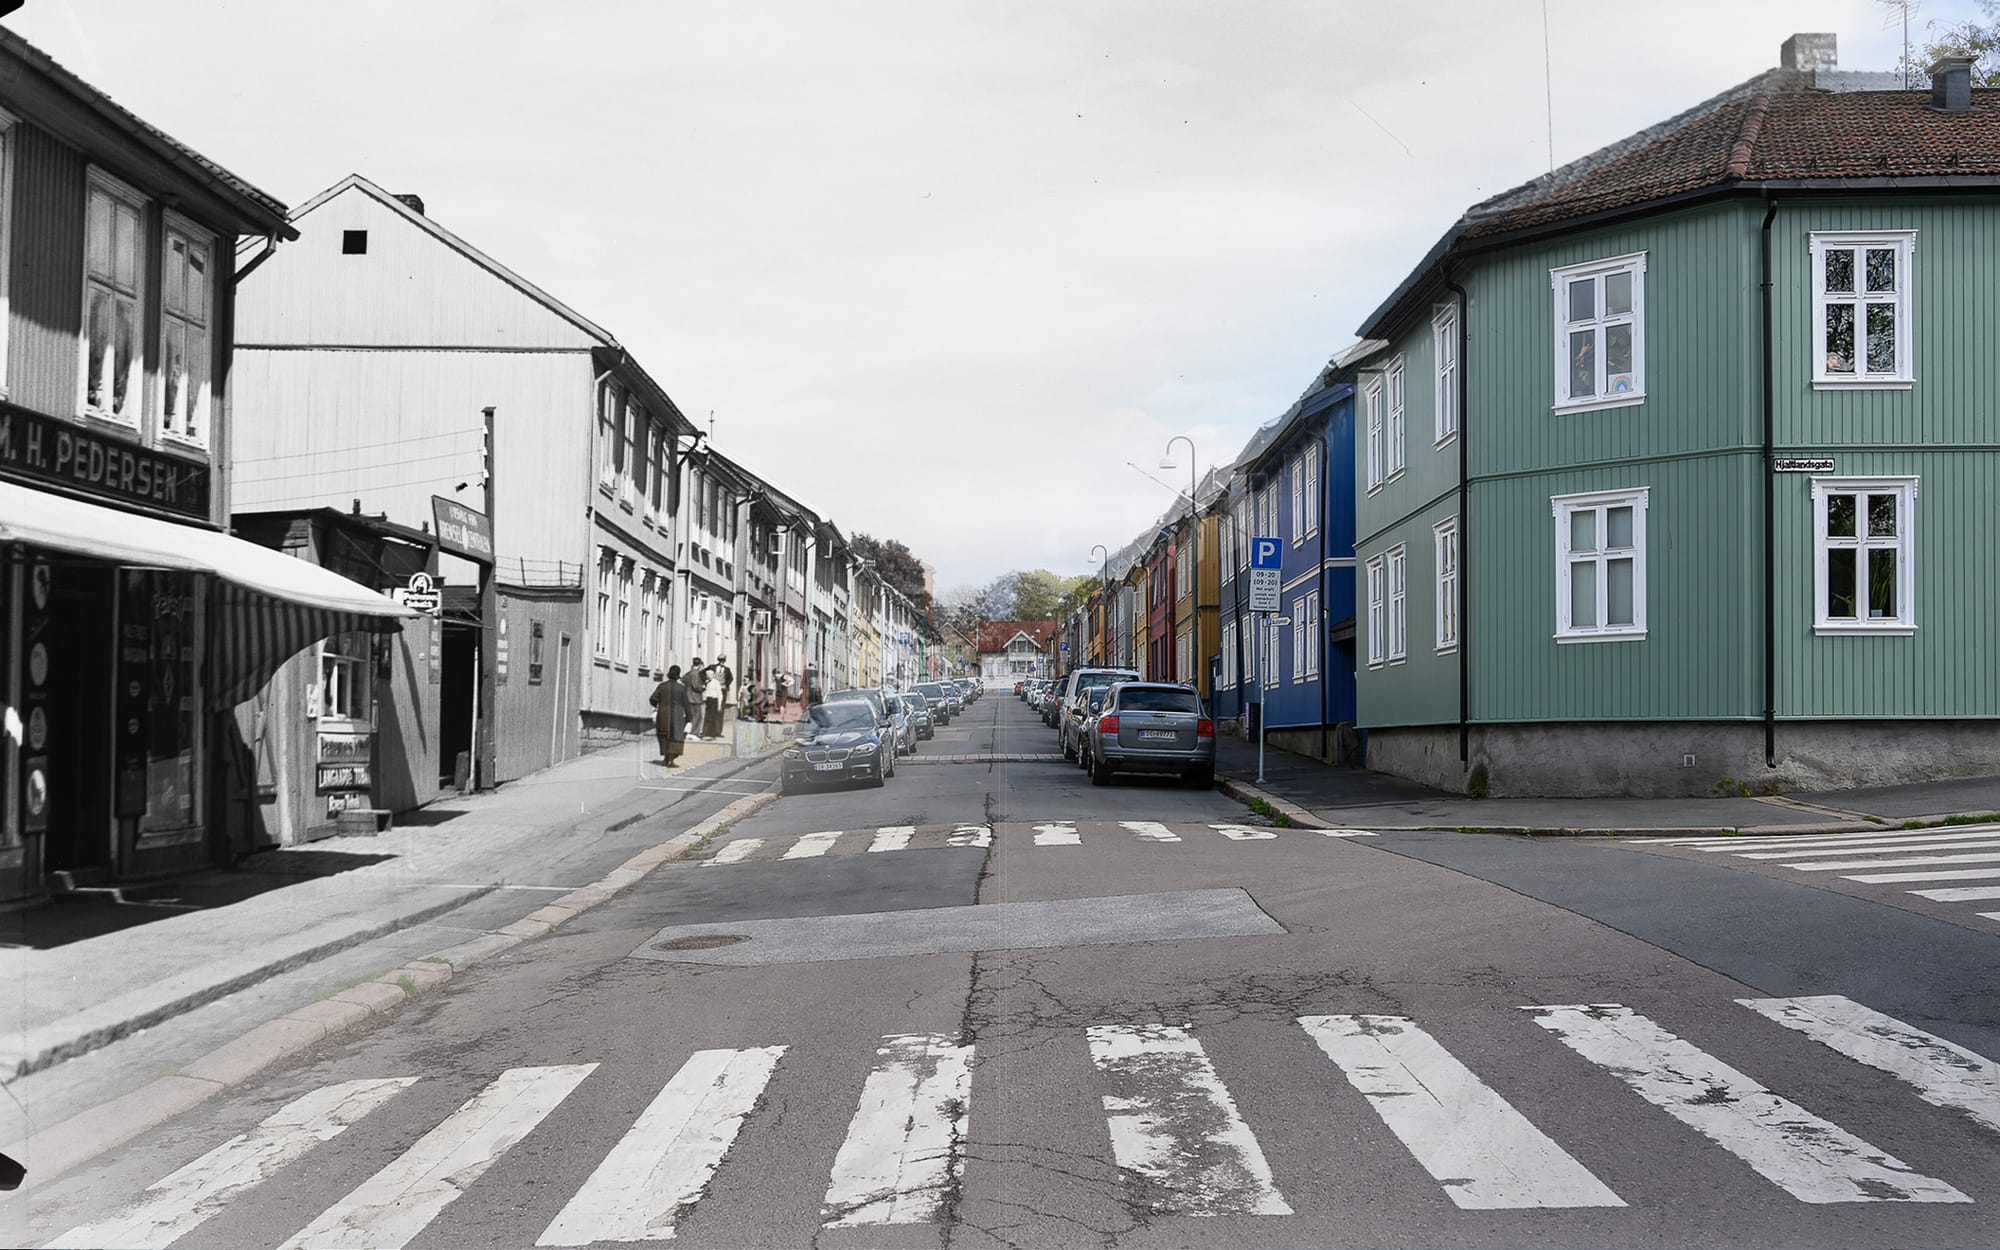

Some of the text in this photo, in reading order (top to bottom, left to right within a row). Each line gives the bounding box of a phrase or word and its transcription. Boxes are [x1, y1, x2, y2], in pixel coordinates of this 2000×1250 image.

[26, 421, 47, 468] H.
[56, 430, 178, 504] PEDERSEN
[1258, 541, 1276, 566] P
